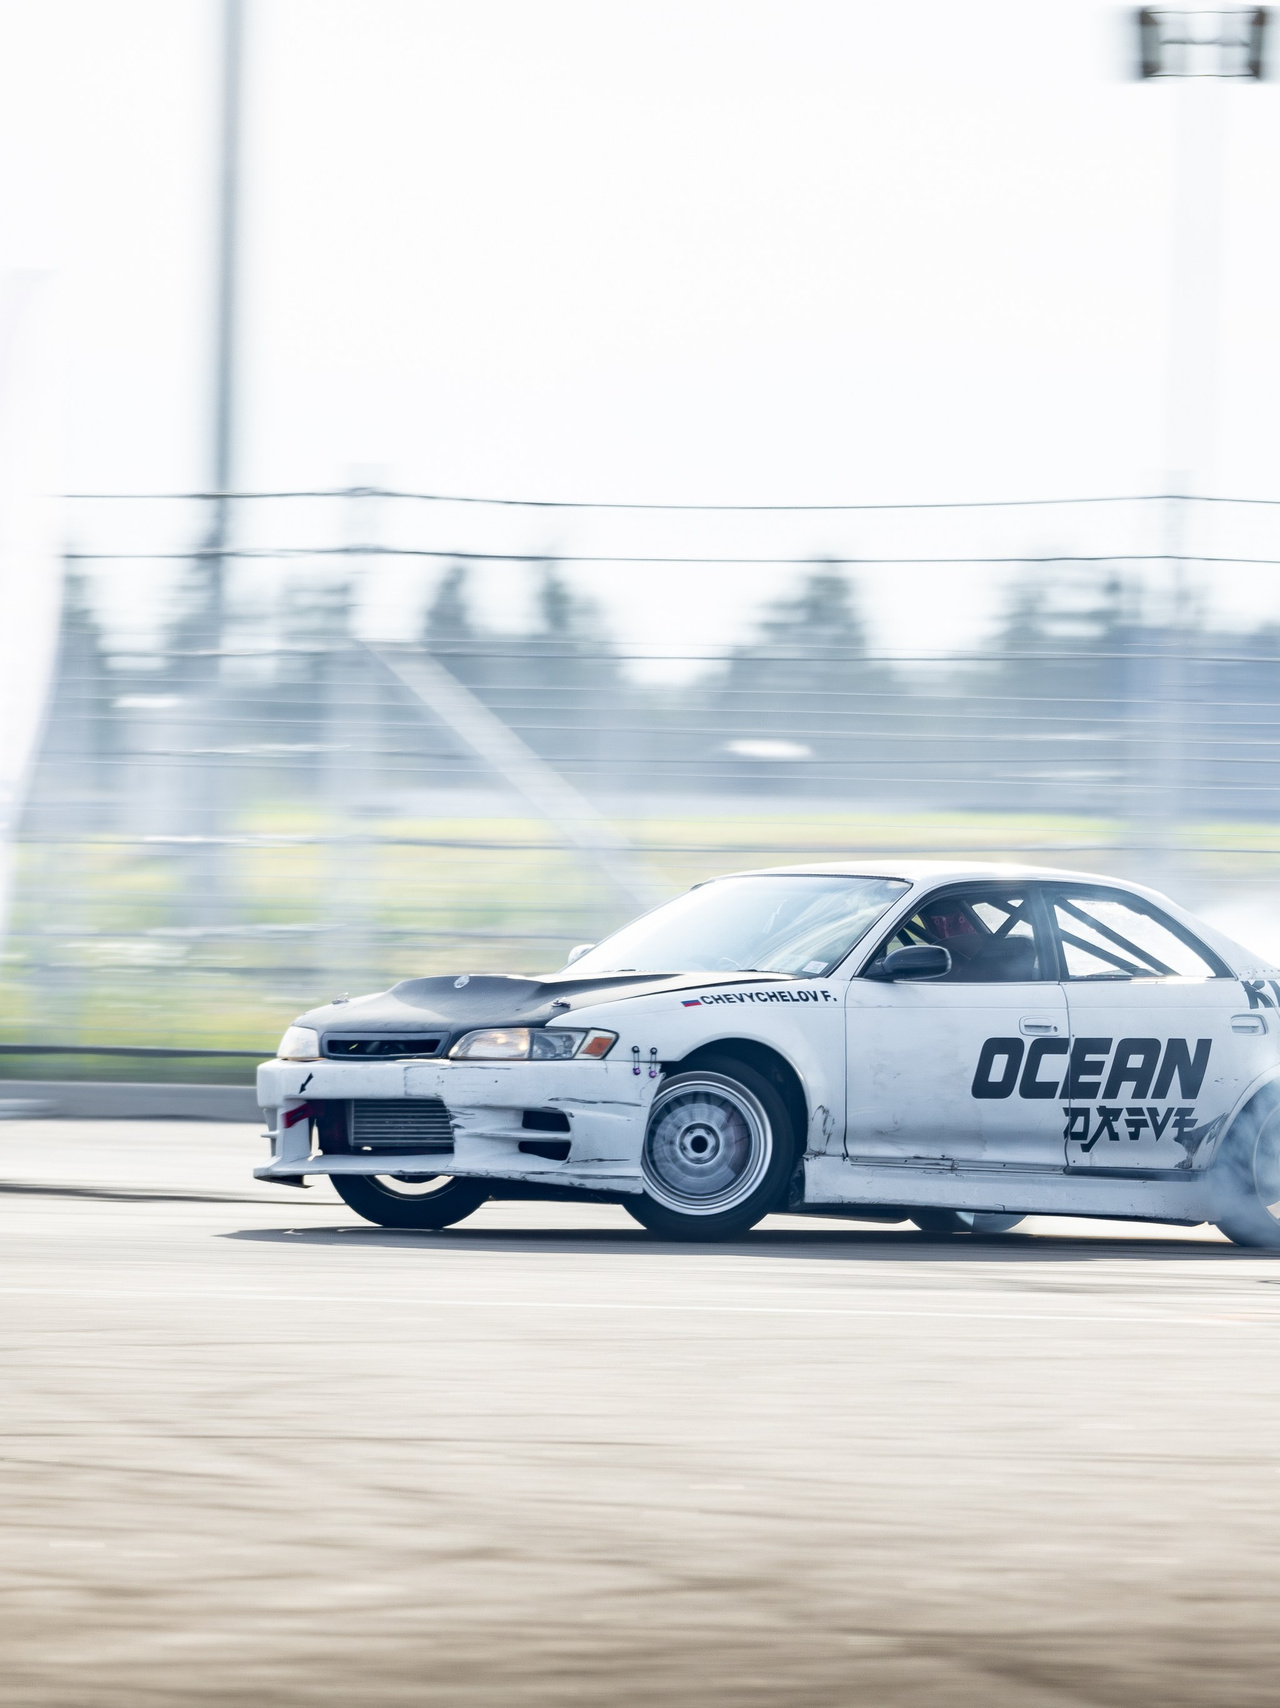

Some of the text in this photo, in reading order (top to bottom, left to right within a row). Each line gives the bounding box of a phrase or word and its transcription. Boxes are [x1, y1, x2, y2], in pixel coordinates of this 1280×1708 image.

[700, 990, 838, 1005] CHEVYCHELOV F.
[971, 1037, 1213, 1099] OCEAN
[1062, 1105, 1199, 1153] DRIVE
